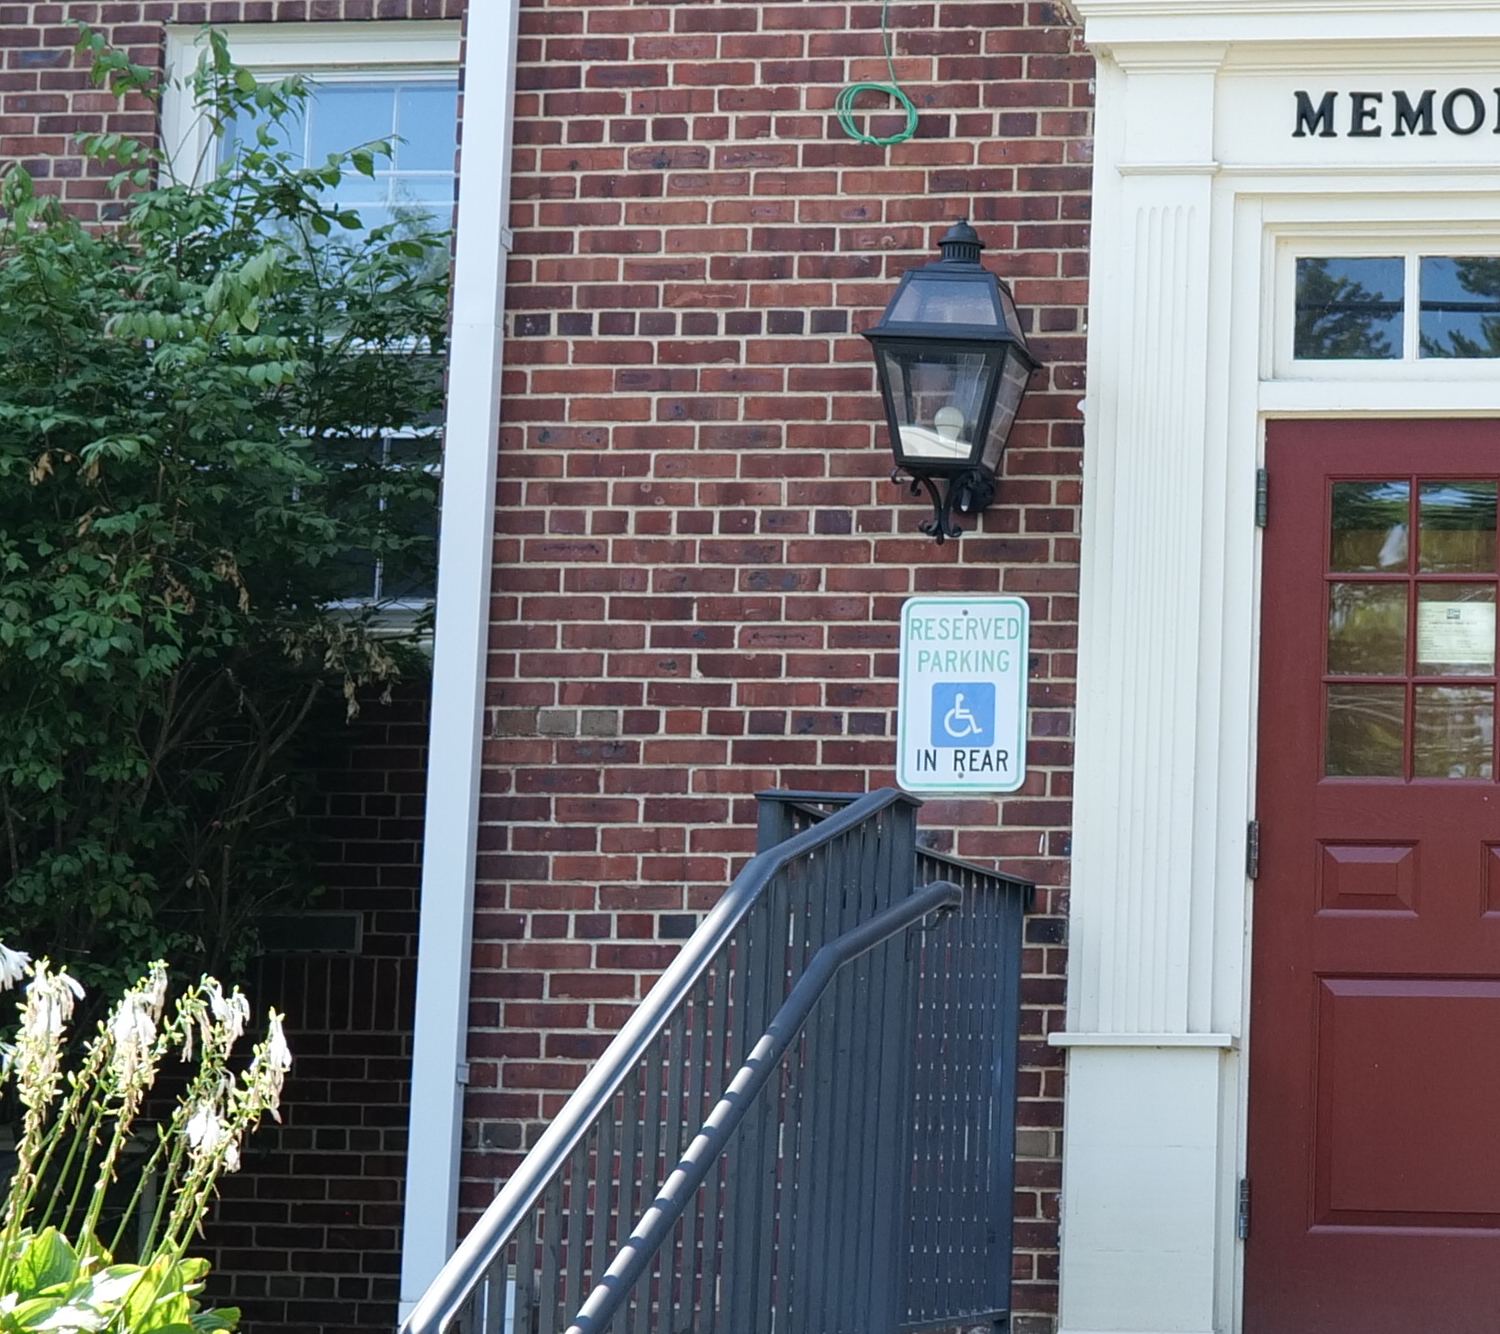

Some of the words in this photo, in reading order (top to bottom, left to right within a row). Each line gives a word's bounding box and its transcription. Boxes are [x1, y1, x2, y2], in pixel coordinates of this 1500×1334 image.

[909, 617, 1021, 641] RESERVED
[917, 649, 1010, 673] PARKING
[915, 748, 937, 772] IN
[952, 749, 1009, 772] REAR
